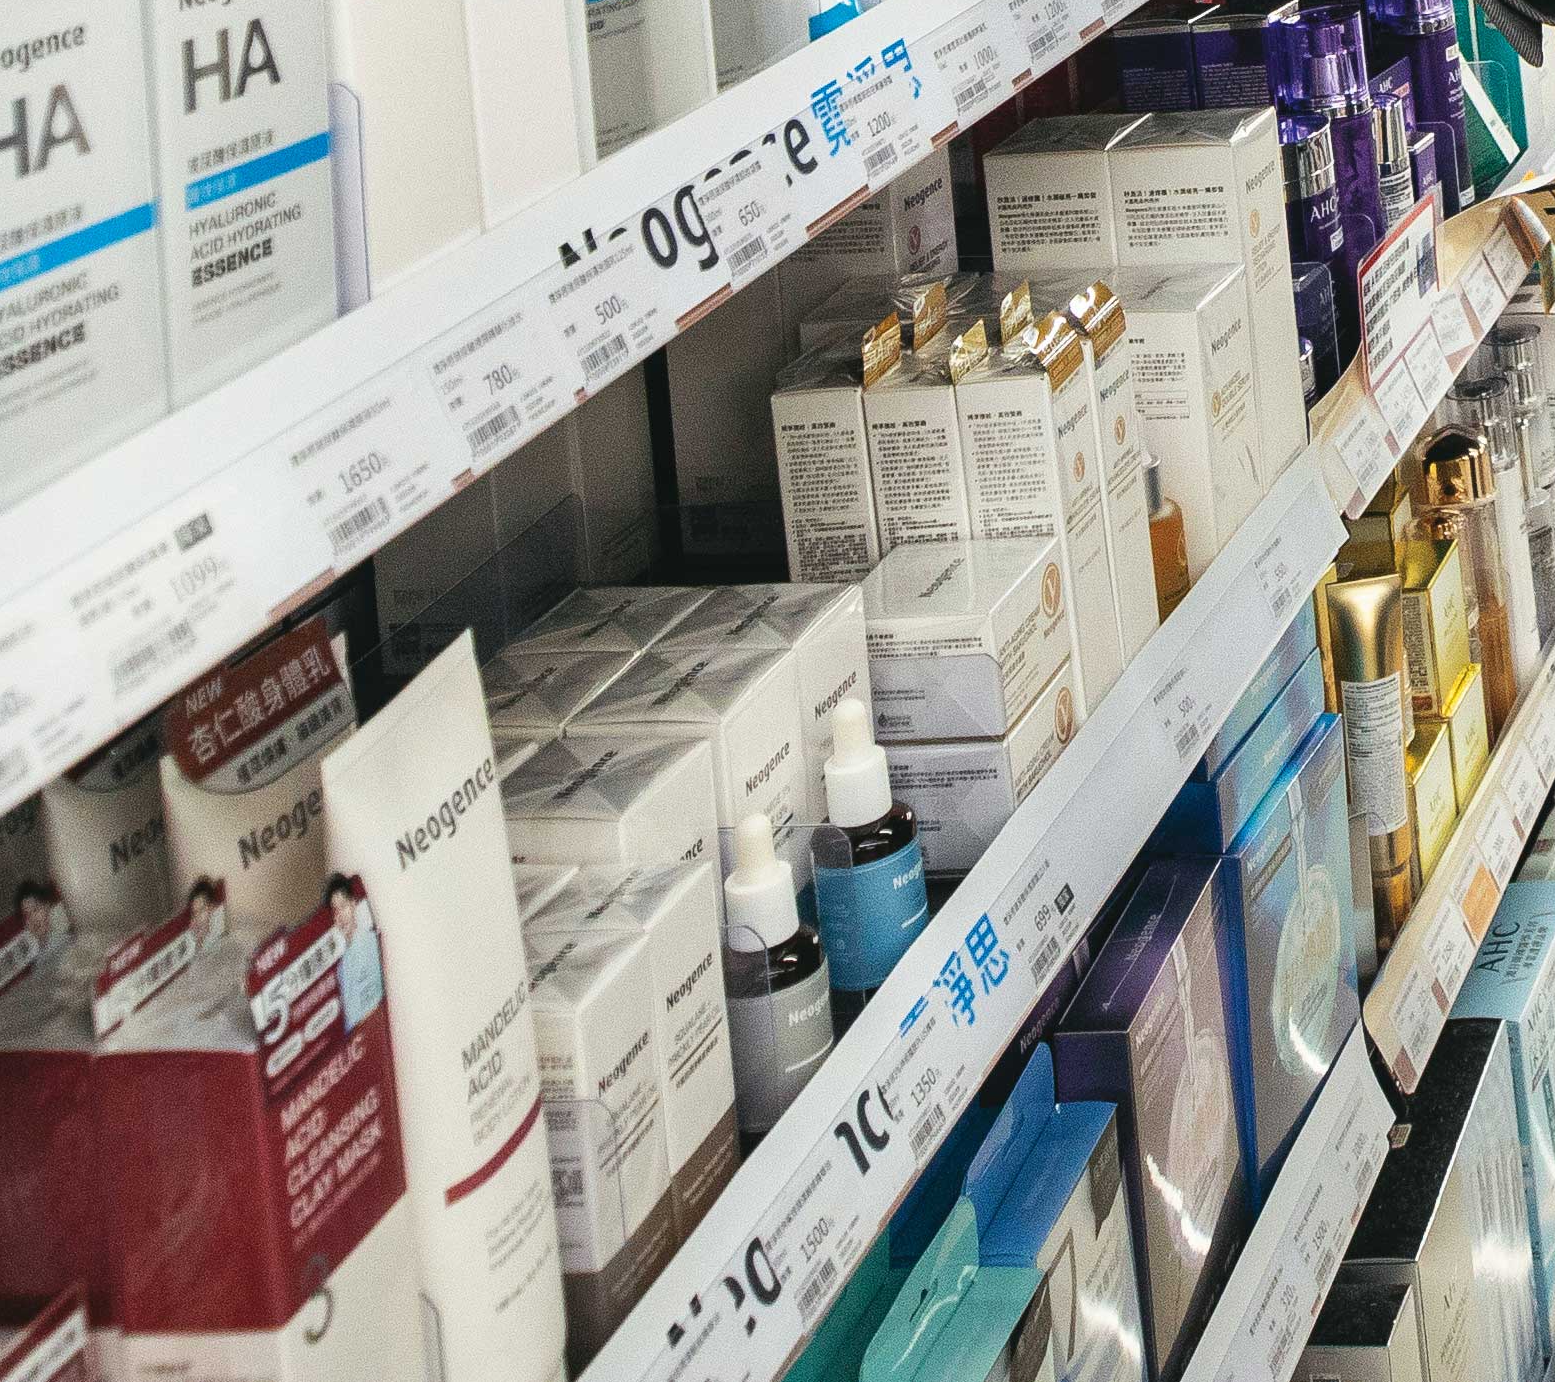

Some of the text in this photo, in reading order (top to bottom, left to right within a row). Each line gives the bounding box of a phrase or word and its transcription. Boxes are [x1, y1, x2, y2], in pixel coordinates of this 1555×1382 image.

[181, 17, 281, 115] HA
[867, 111, 892, 139] 1200
[902, 176, 943, 212] Neogence
[1244, 158, 1277, 195] Neogence
[188, 191, 277, 237] HYALURONIC
[190, 203, 302, 264] ACID HYDRATING
[737, 200, 762, 228] 650
[1310, 196, 1338, 224] AHC
[191, 237, 274, 289] ESSENCE
[594, 293, 623, 328] 500
[483, 363, 515, 398] 780
[337, 449, 385, 497] 1650
[814, 669, 858, 722] Neogence
[744, 740, 791, 800] Neogence
[394, 755, 496, 871] Neogence
[1032, 903, 1052, 934] 699
[1479, 919, 1520, 975] AHC
[665, 951, 714, 1015] Neogence
[461, 980, 527, 1074] MANDELIC
[467, 1049, 503, 1103] ACID
[597, 1031, 650, 1097] Neogence
[909, 1066, 939, 1109] 1350
